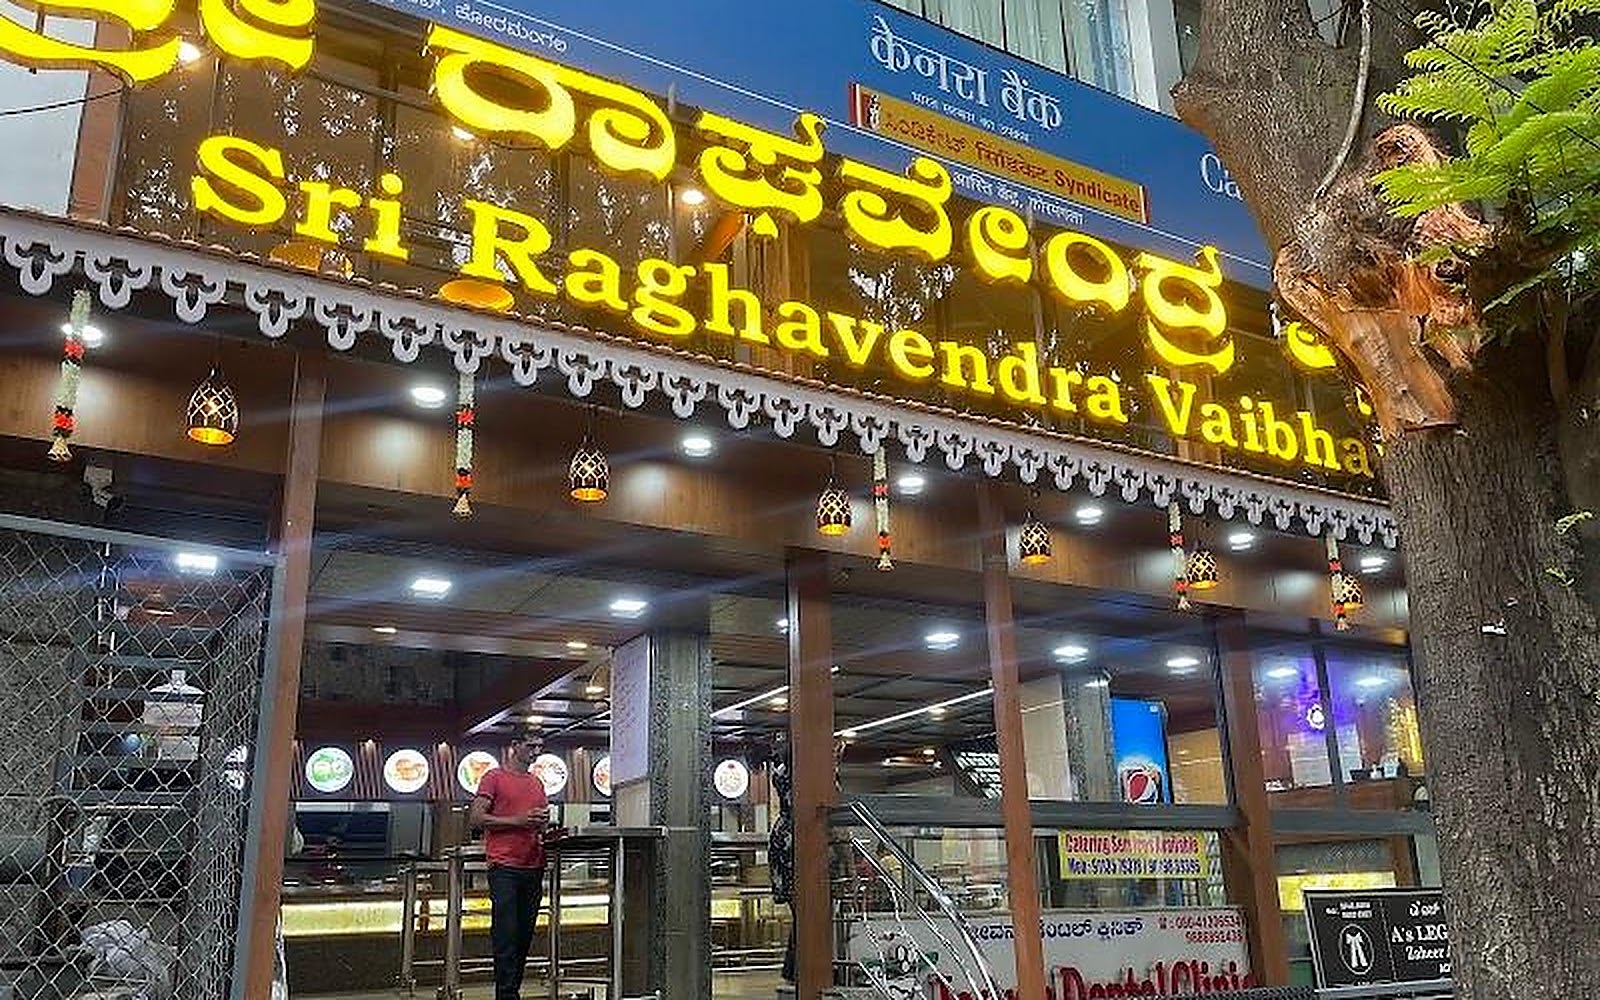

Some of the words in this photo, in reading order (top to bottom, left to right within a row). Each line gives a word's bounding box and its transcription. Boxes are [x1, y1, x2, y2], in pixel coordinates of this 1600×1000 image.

[870, 14, 989, 108] केनरा
[1000, 69, 1063, 131] बैंक
[428, 25, 1234, 374] ರಾಘವೇಂದ್ರ
[1054, 169, 1142, 213] Syndicate
[191, 135, 409, 261] Sri
[458, 199, 1128, 424] Raghavendra
[1146, 373, 1384, 478] Vaibha
[1392, 926, 1415, 943] A's
[1405, 945, 1444, 961] Zaheer
